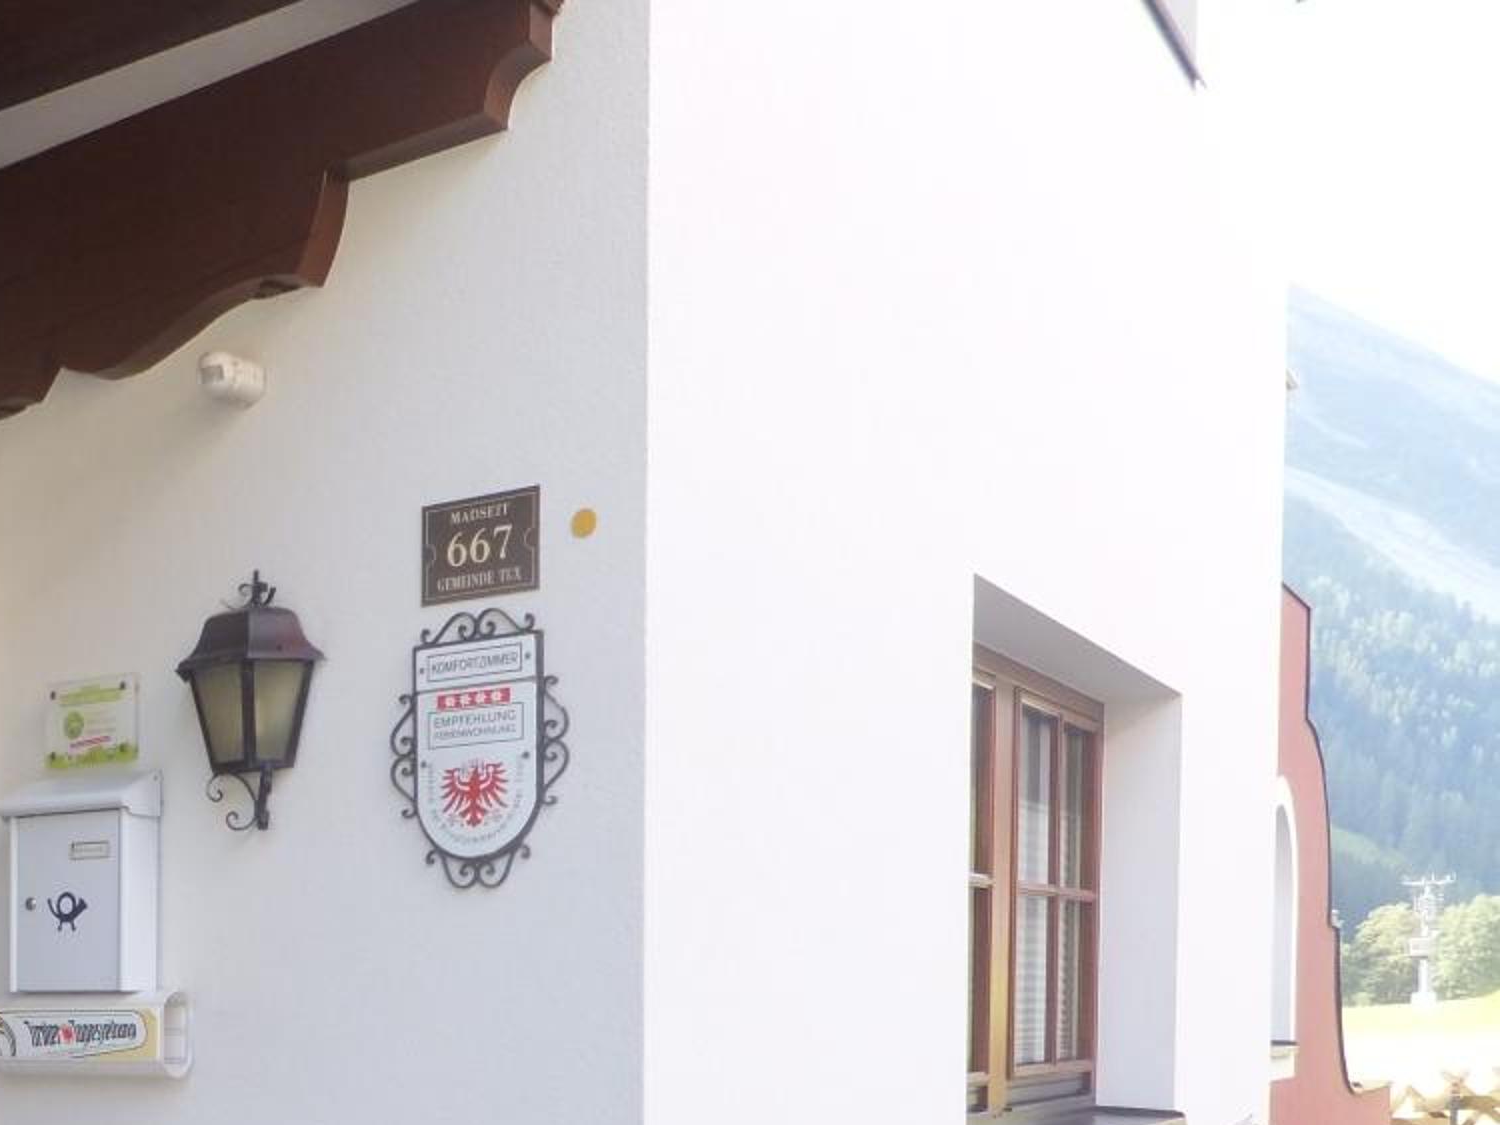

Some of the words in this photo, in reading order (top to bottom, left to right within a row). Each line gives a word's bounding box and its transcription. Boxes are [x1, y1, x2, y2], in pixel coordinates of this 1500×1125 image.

[446, 524, 512, 567] 667
[436, 570, 494, 592] GEMEINDE
[434, 709, 516, 729] EMPFEHLUNG
